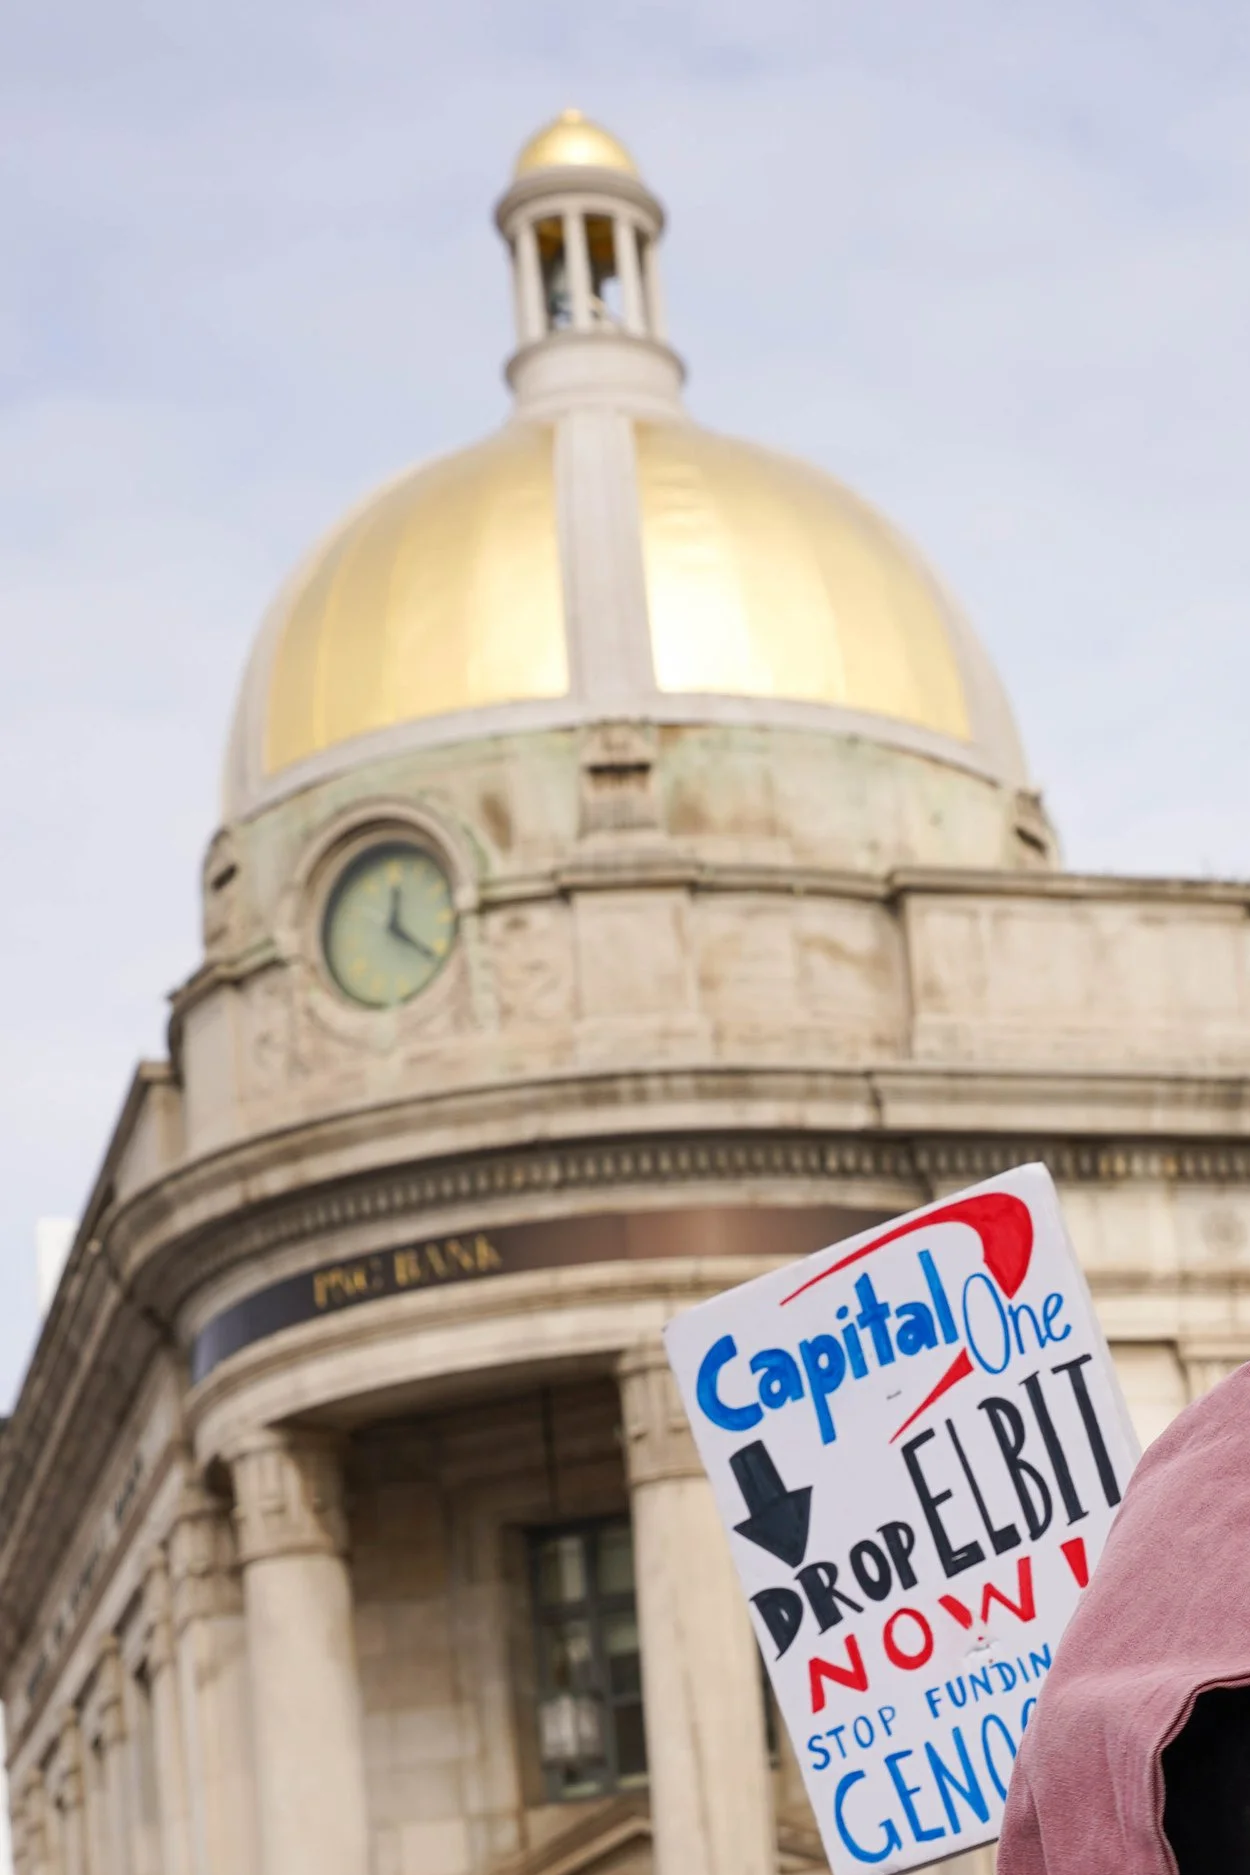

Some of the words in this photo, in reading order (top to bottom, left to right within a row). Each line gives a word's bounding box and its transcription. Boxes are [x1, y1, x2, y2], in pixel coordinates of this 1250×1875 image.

[696, 1249, 960, 1446] Capital
[961, 1271, 1073, 1375] One
[749, 1520, 917, 1662] DROP
[900, 1353, 1122, 1580] ELBIT
[807, 1706, 896, 1772] STOP
